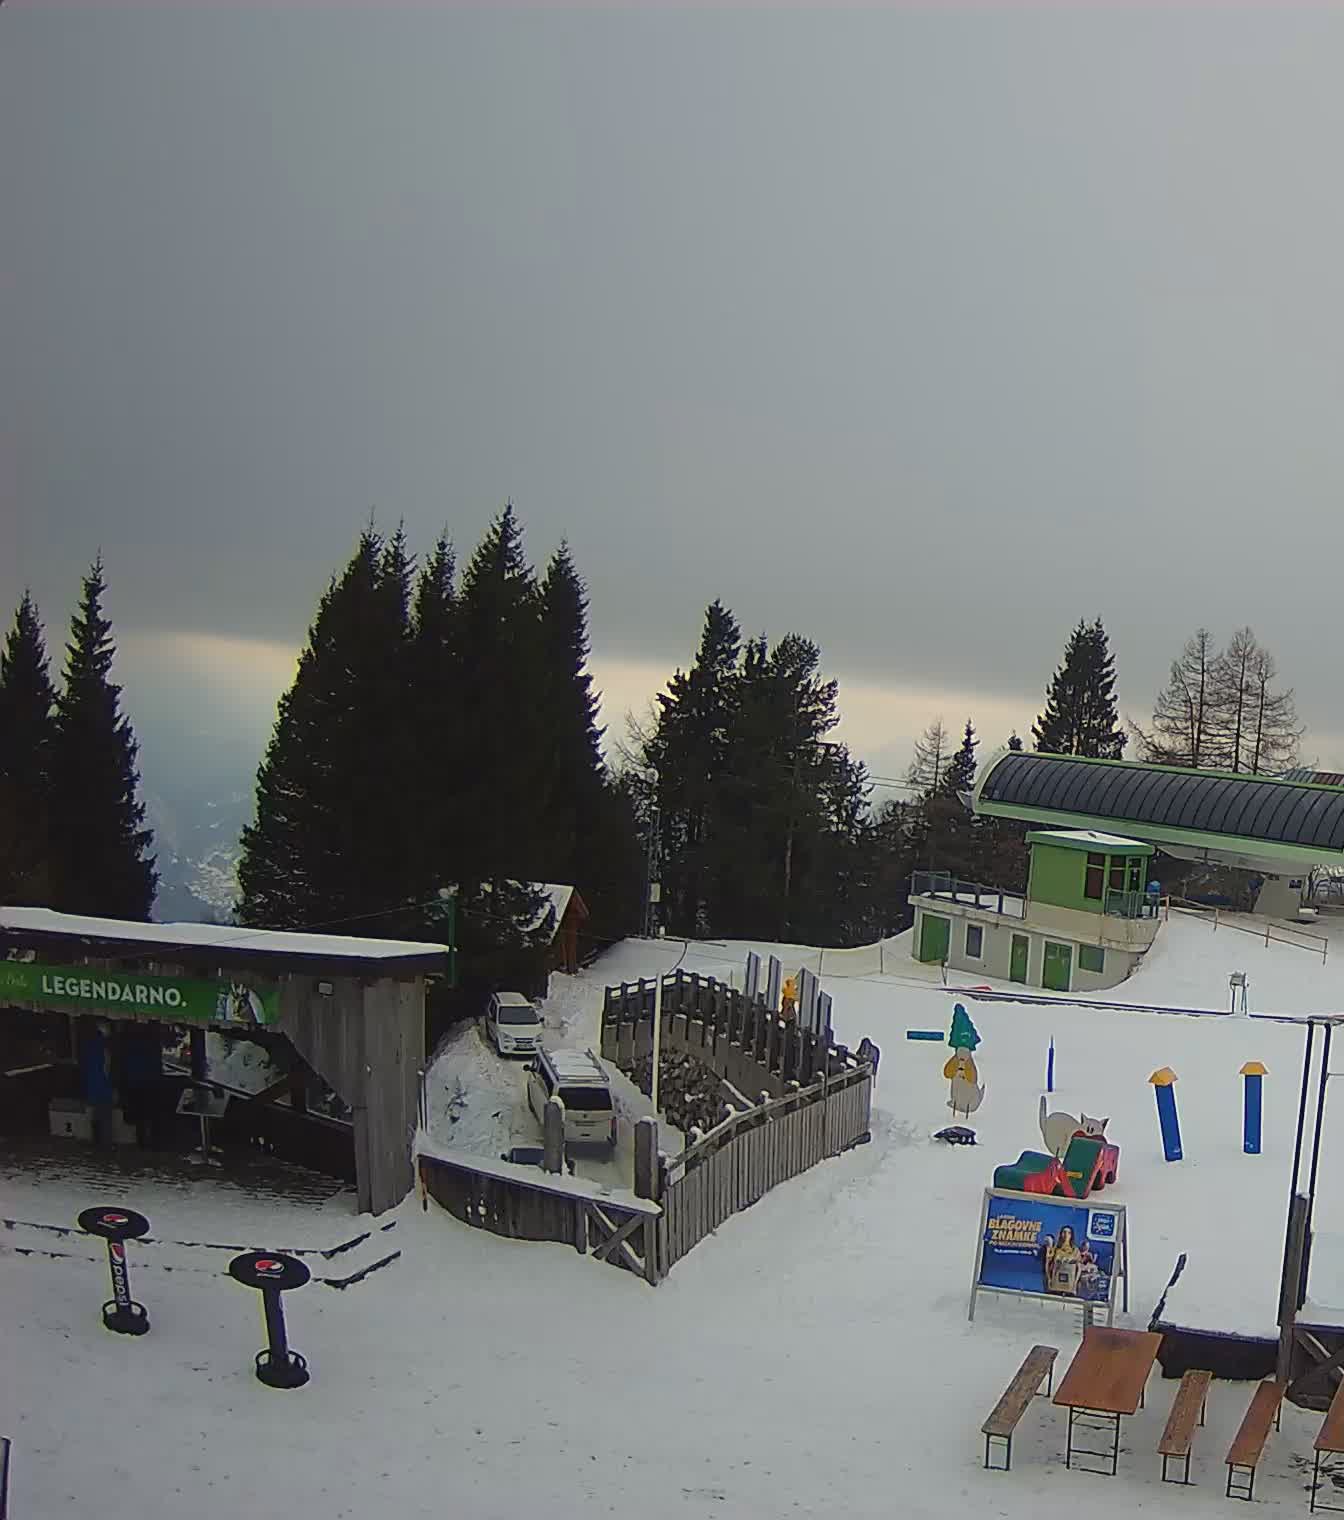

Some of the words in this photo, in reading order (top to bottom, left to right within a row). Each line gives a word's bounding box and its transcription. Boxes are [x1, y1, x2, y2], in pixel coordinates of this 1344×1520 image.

[41, 974, 188, 1008] LEGENDARNO.
[988, 1218, 1042, 1233] BLAGOVNE
[991, 1229, 1038, 1243] ZNAMKE
